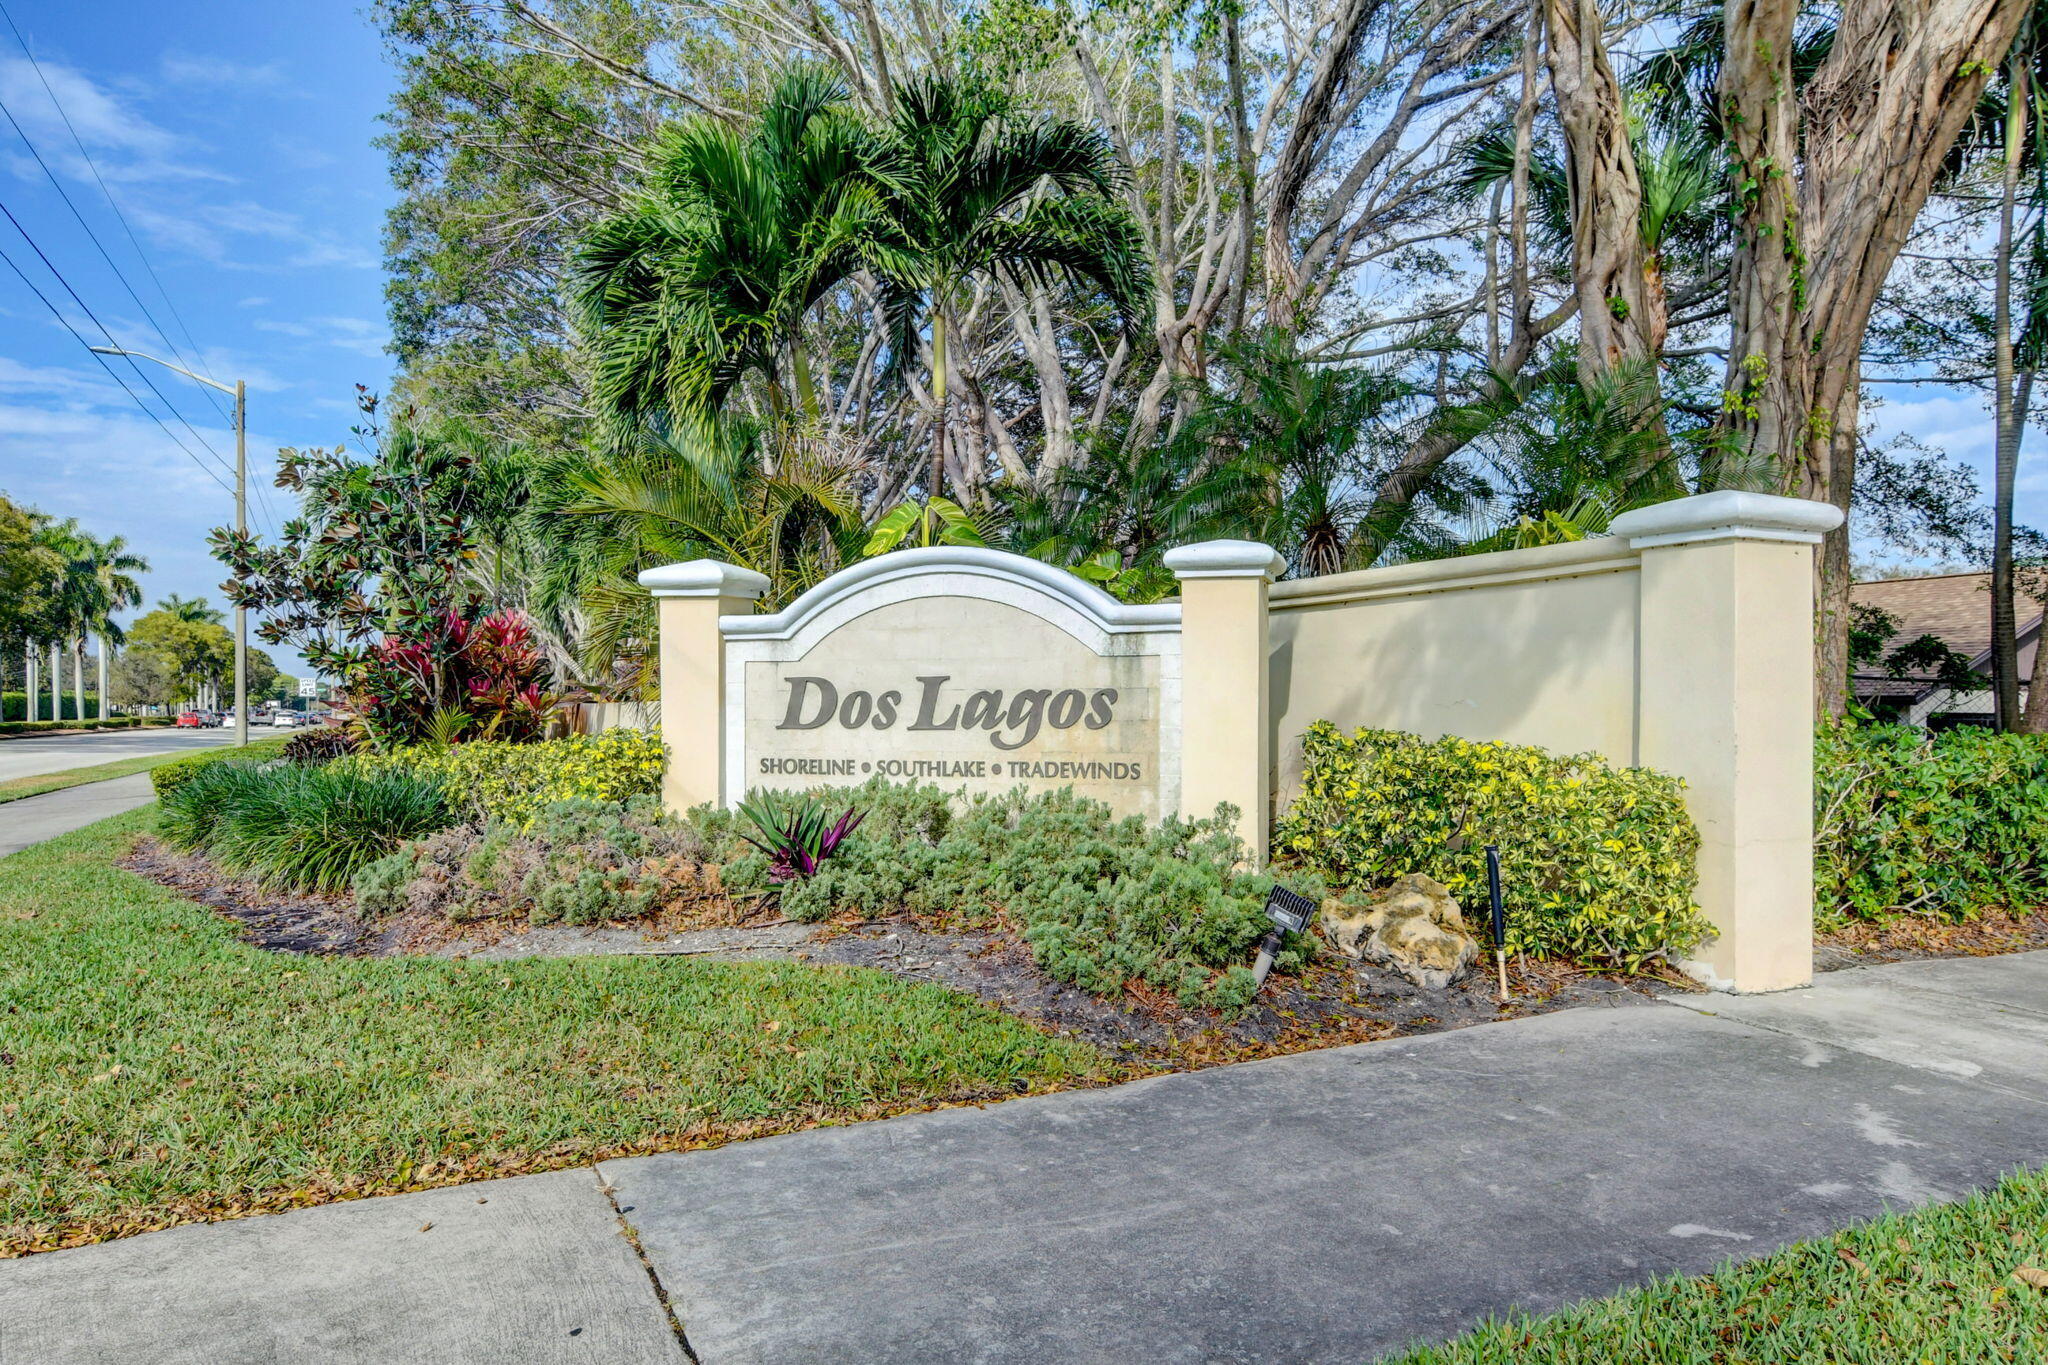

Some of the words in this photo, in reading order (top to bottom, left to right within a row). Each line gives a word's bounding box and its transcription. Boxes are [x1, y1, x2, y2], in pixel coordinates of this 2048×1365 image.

[301, 687, 315, 695] 45
[775, 676, 902, 731] Dos
[906, 676, 1118, 750] Lagos
[760, 758, 856, 777] SHORELINE
[876, 760, 986, 778] SOUTHLAKE
[1008, 761, 1141, 780] TRADEWINDS
